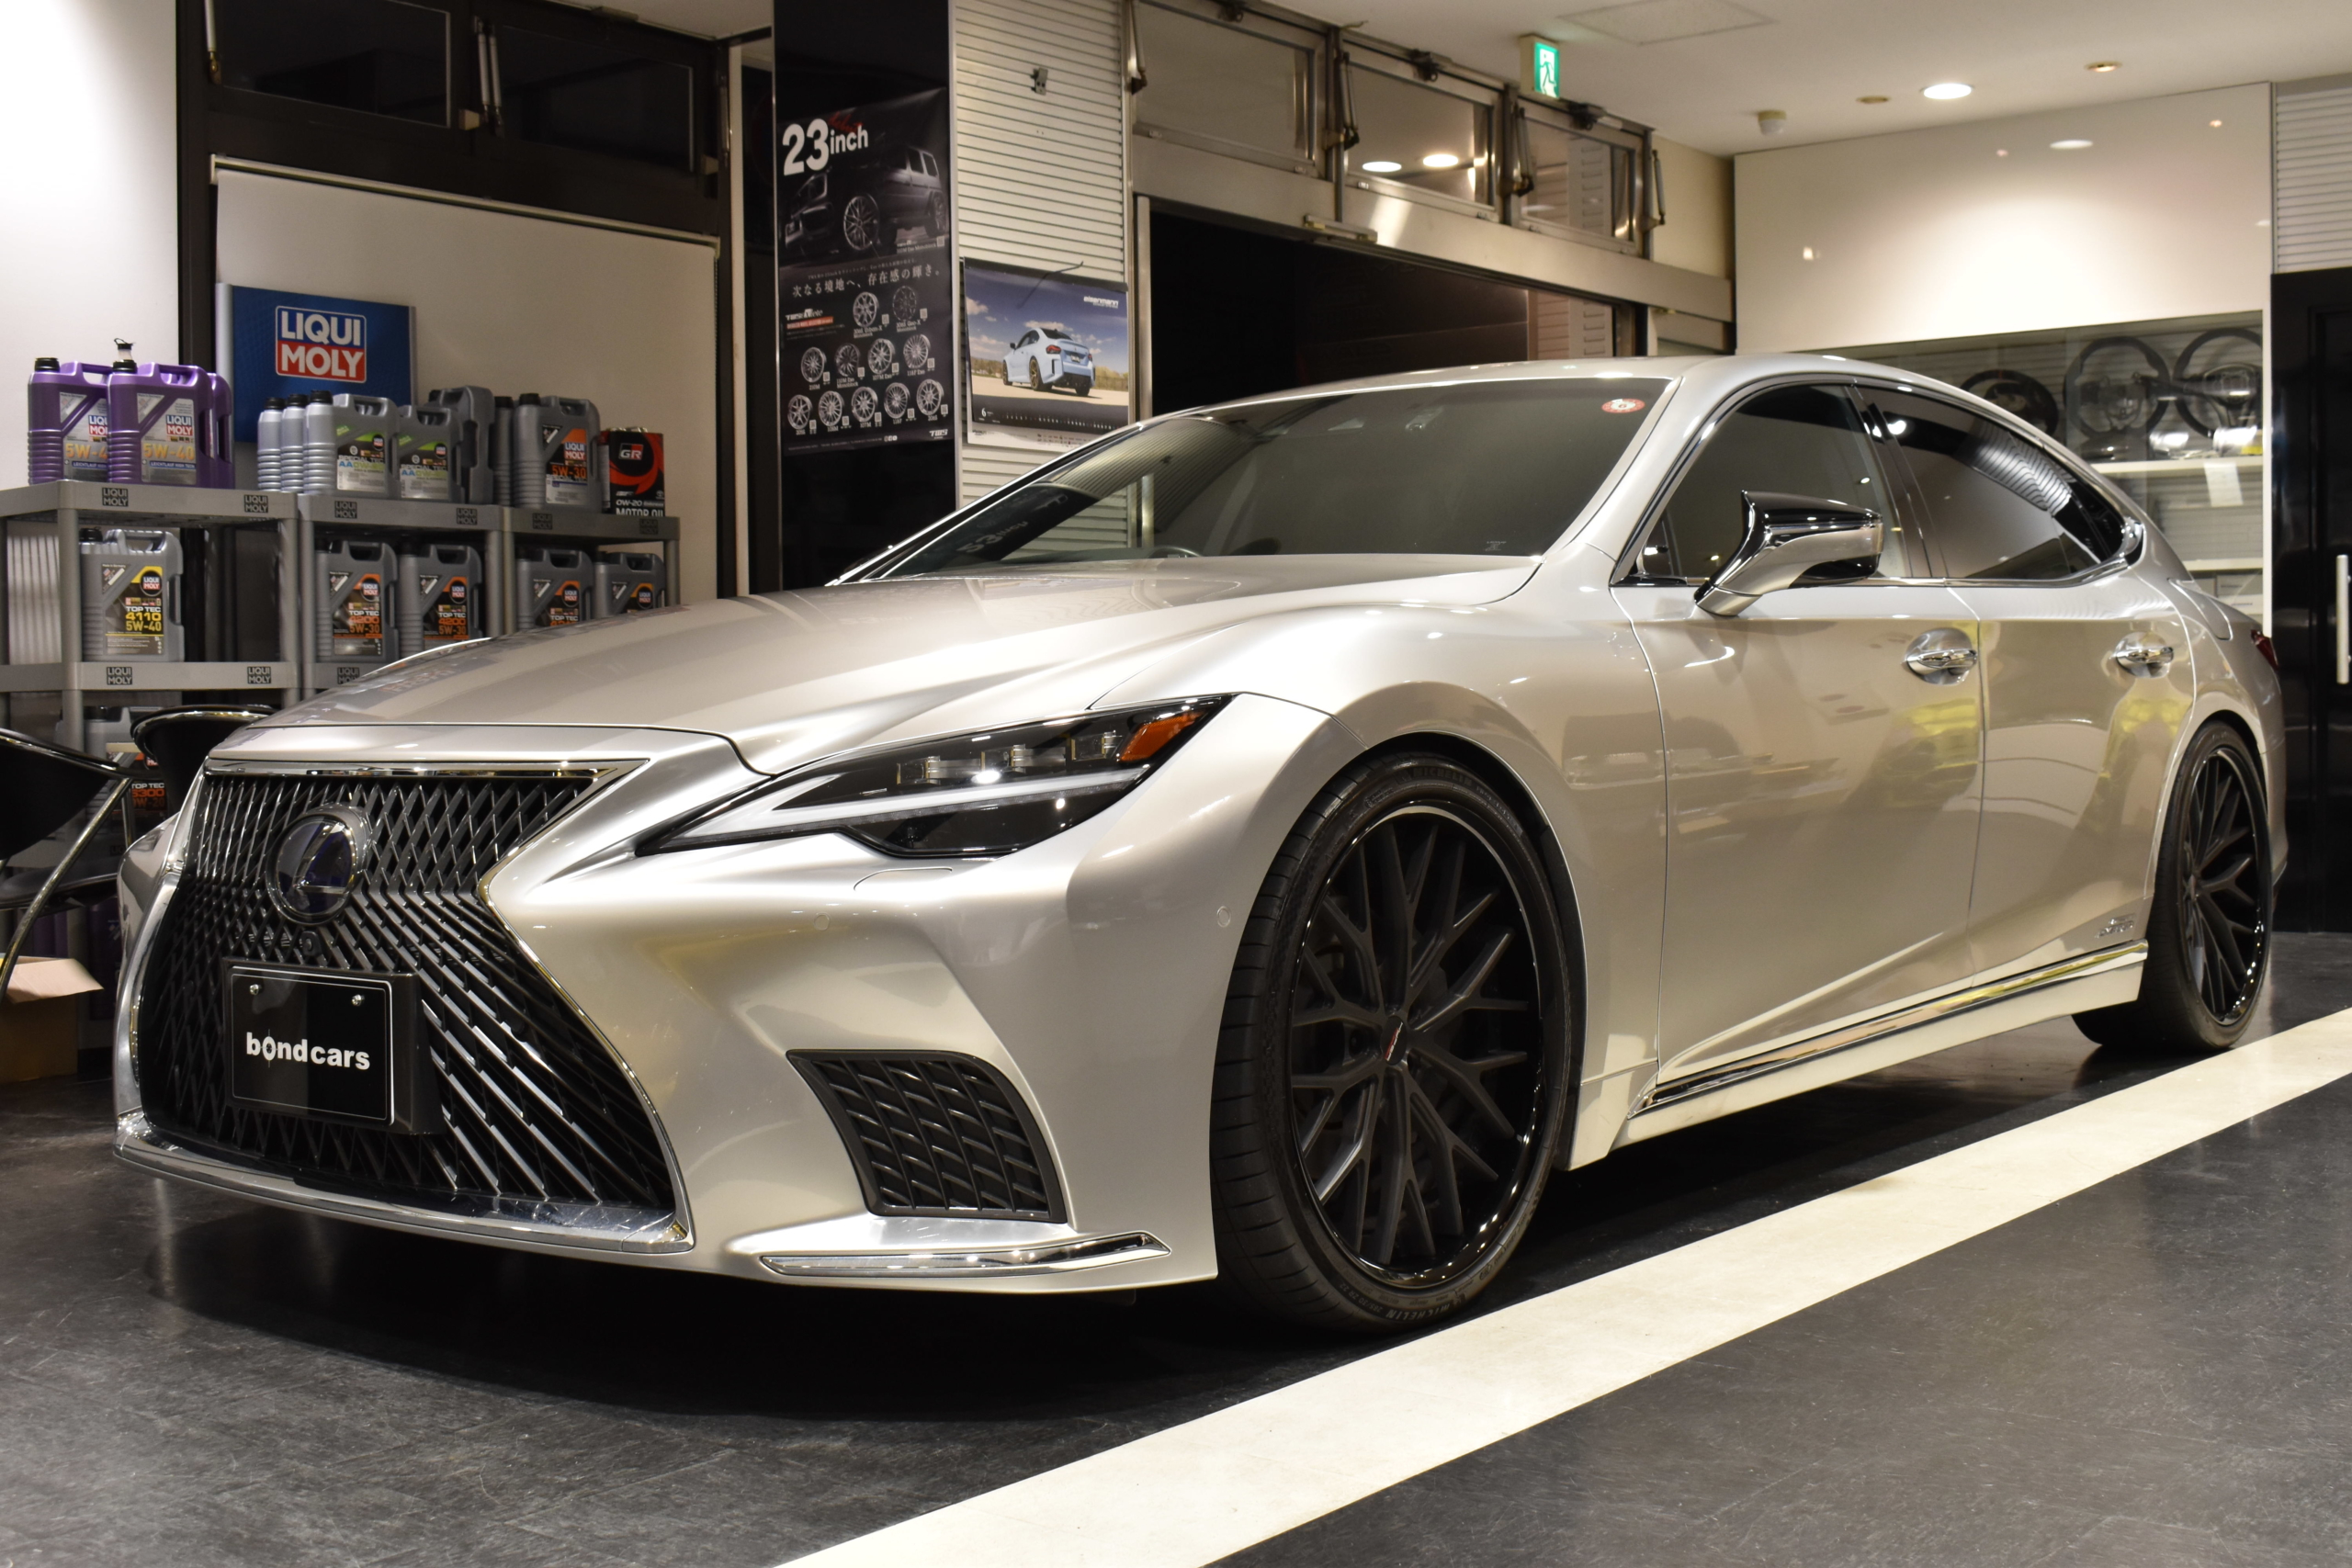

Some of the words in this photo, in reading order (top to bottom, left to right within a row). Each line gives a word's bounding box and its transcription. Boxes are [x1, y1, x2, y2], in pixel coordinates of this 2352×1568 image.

[783, 118, 829, 176] 23
[831, 125, 868, 154] inch
[281, 310, 361, 346] LIQUI
[281, 344, 364, 378] MOLY
[981, 408, 987, 417] 6
[89, 415, 107, 425] LIQU
[167, 415, 192, 425] LIQUI
[89, 425, 107, 435] MOL
[167, 426, 193, 435] MOLY
[65, 443, 107, 459] 5W-4
[143, 443, 194, 460] 5W-40
[565, 451, 586, 459] MOLY
[620, 449, 642, 459] GR
[551, 465, 586, 479] 5W-30
[103, 489, 127, 497] LIQUI
[103, 497, 128, 505] MOLY
[125, 613, 162, 621] 4110
[126, 621, 162, 631] 5W-40
[349, 625, 380, 633] 5W-30
[439, 626, 466, 635] 5W-30
[107, 667, 131, 676] LIQUI
[248, 667, 270, 675] LIQUI
[107, 676, 132, 684] MOLY
[248, 675, 271, 683] MOLY
[1385, 1303, 1450, 1320] MICHELIN
